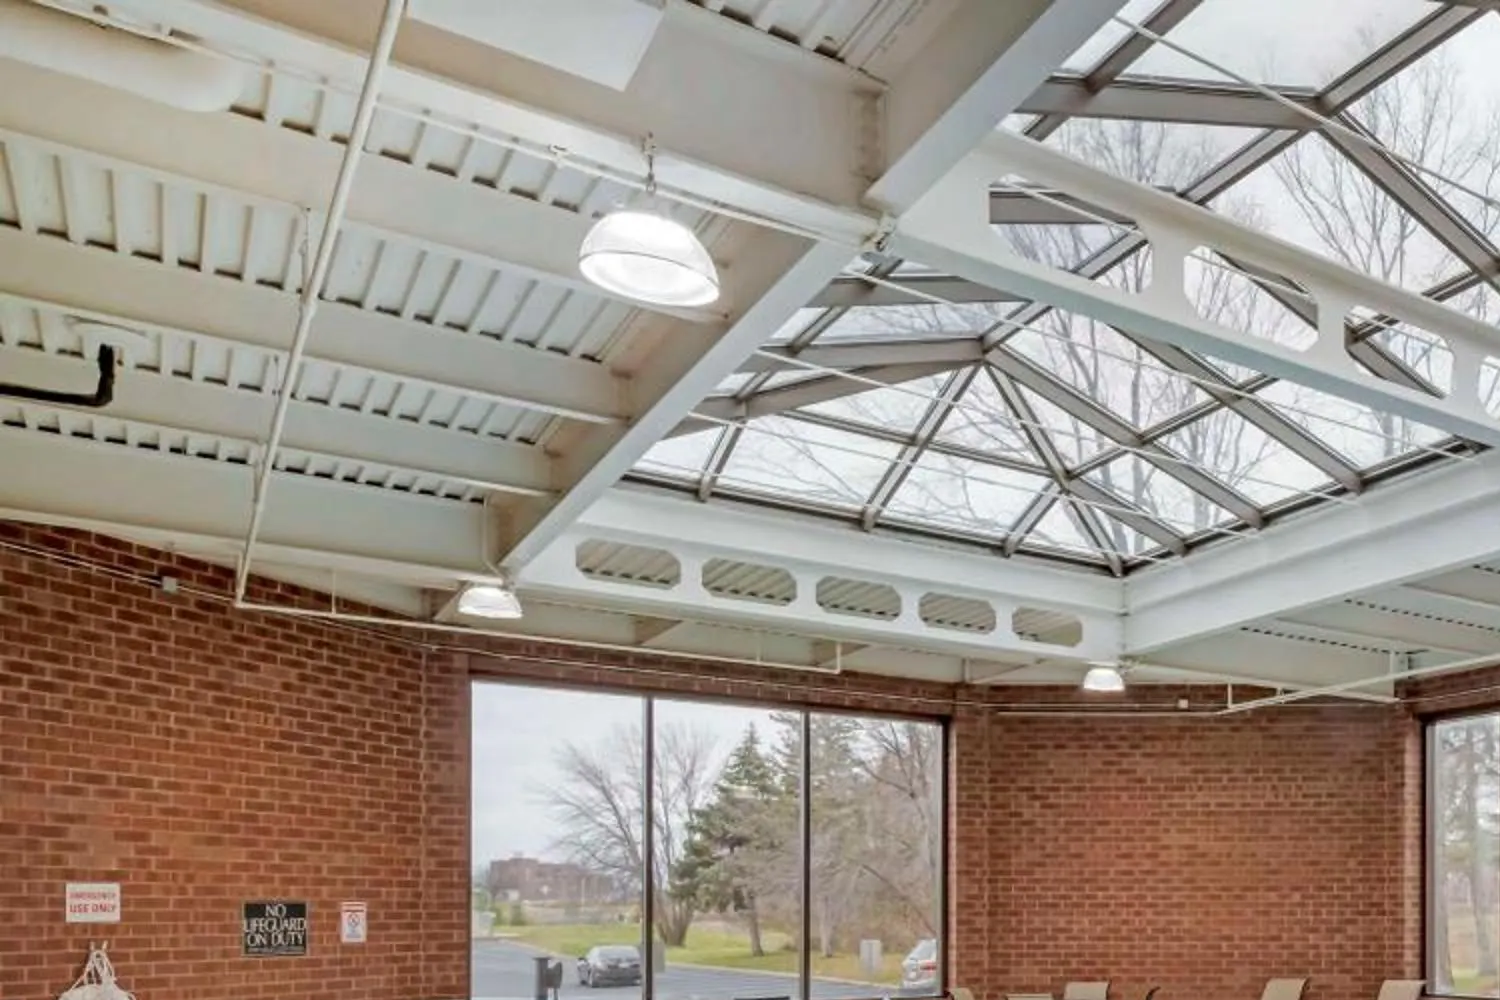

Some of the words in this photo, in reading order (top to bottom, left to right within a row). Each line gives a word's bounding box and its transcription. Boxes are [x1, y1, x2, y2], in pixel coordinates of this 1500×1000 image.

[69, 903, 90, 913] USE
[91, 903, 116, 913] ONLY
[265, 903, 287, 917] NO
[244, 917, 307, 932] LIFEGUARD
[247, 933, 268, 947] ON
[271, 931, 304, 946] DUTY
